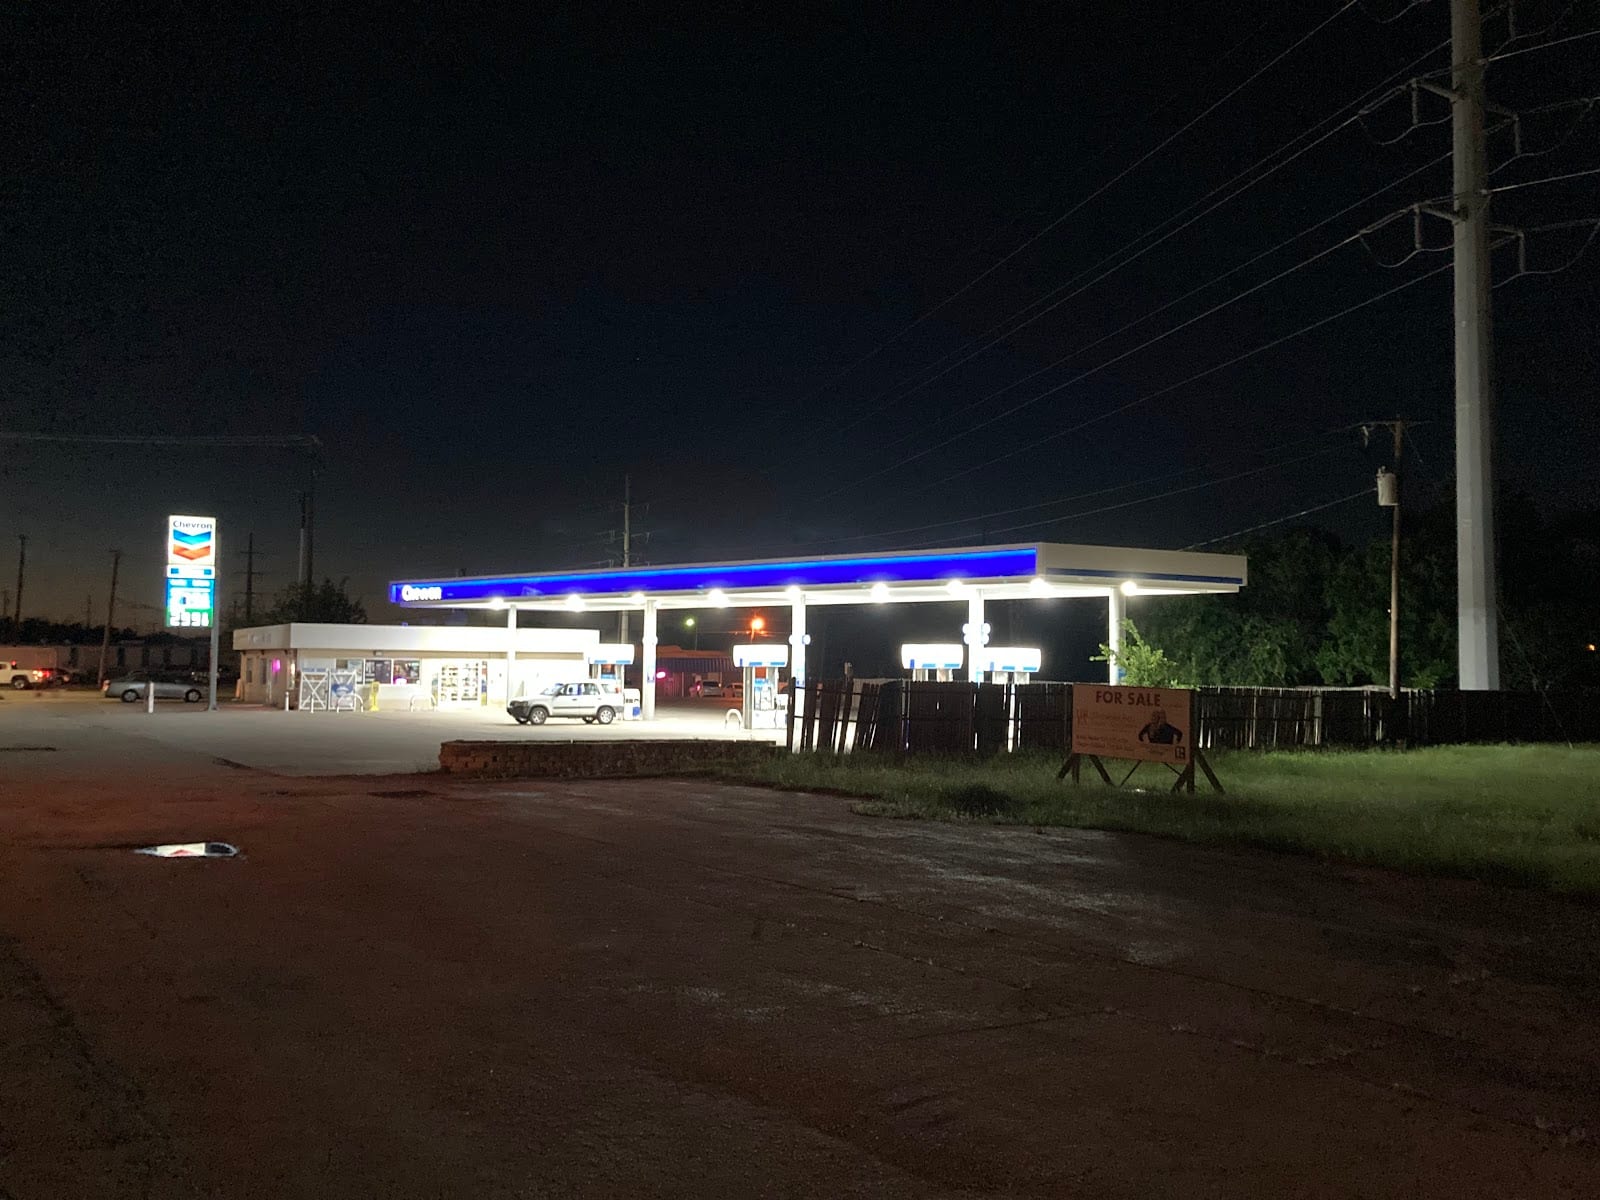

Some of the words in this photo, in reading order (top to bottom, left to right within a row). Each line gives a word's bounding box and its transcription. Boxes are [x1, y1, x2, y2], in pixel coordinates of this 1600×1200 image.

[173, 520, 213, 530] Chevron
[1095, 690, 1123, 705] FOR
[1127, 692, 1161, 707] SALE
